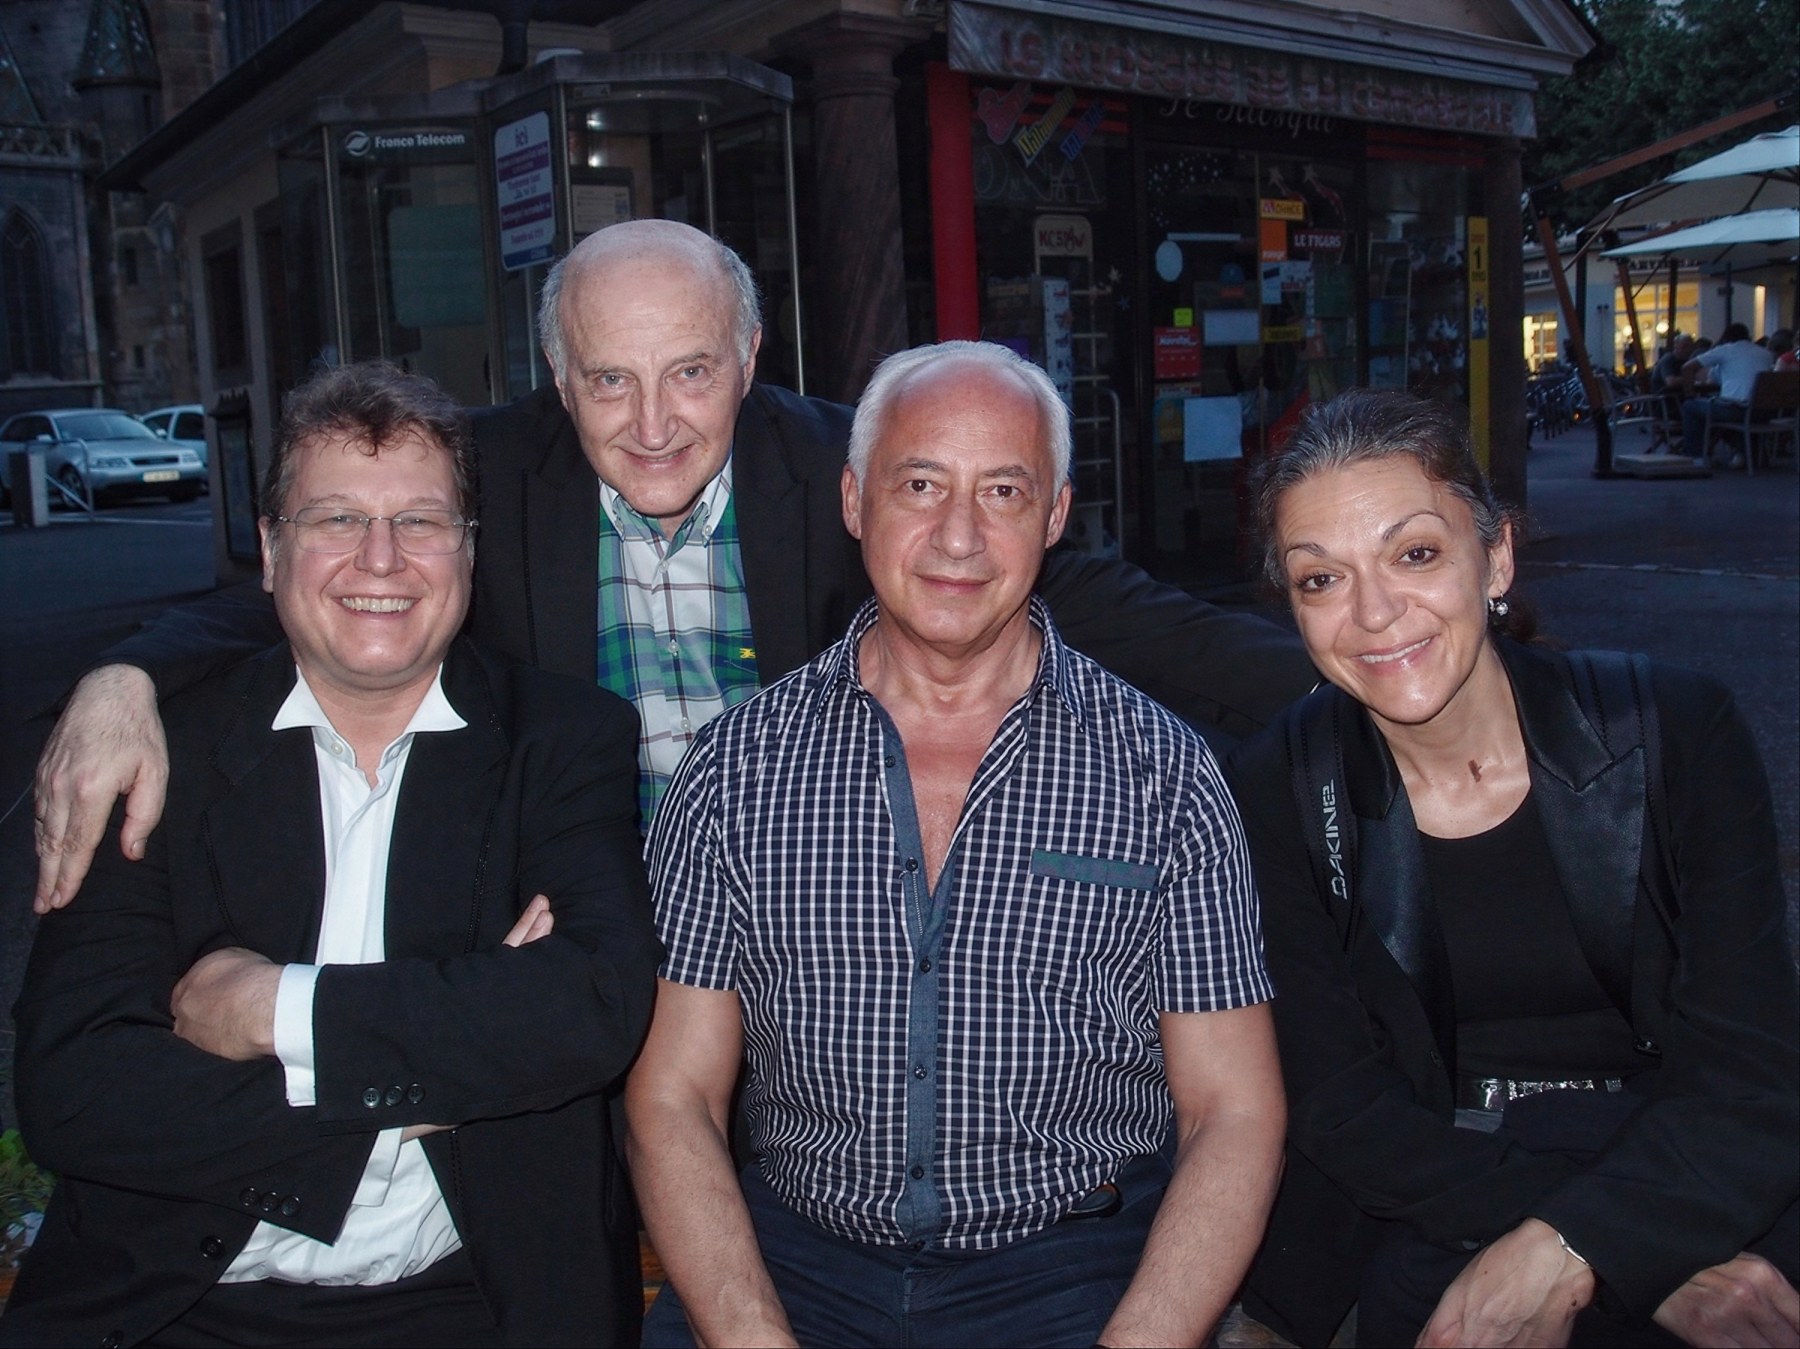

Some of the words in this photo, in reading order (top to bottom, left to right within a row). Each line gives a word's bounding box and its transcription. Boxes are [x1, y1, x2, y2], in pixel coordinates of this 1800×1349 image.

[374, 135, 414, 149] France
[416, 132, 466, 146] Telecom
[1294, 234, 1307, 248] LE
[1322, 778, 1348, 901] DAKINE
